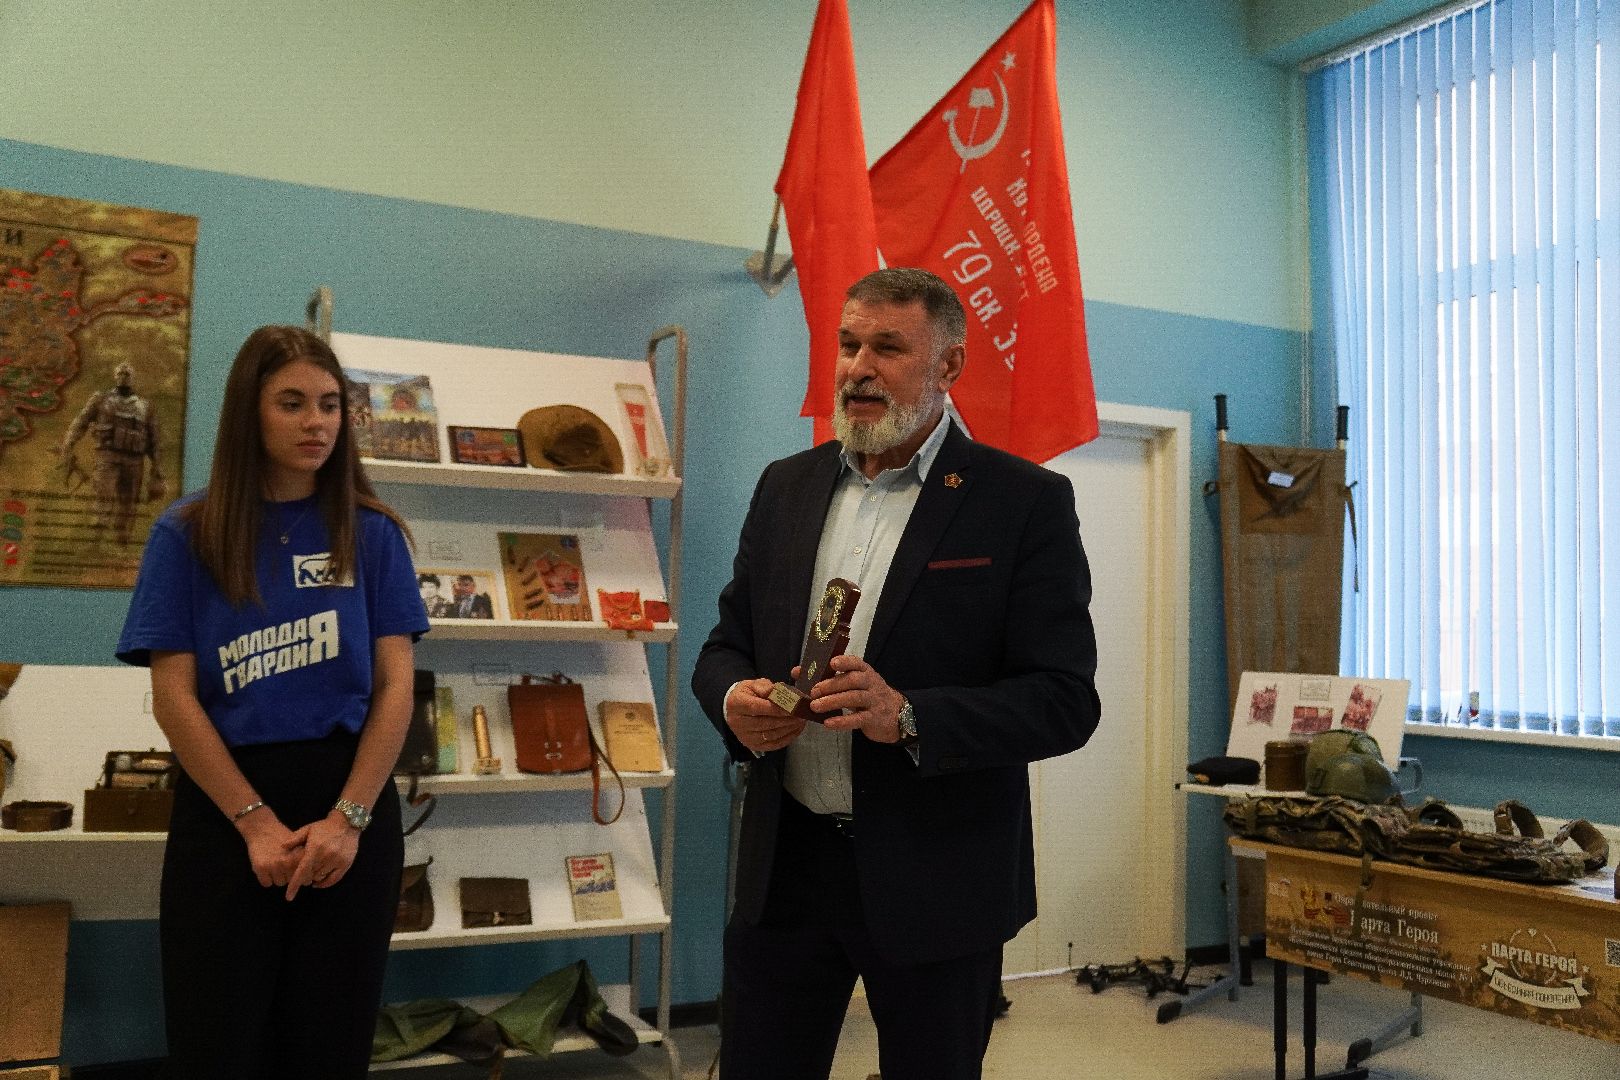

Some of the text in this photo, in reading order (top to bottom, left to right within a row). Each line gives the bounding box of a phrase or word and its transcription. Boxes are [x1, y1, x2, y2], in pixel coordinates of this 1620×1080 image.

[943, 229, 993, 284] 79
[218, 609, 339, 669] МОЛОДАЯ
[1397, 918, 1438, 945] Героя
[1491, 941, 1577, 975] ПАРТА ГЕРОЯ
